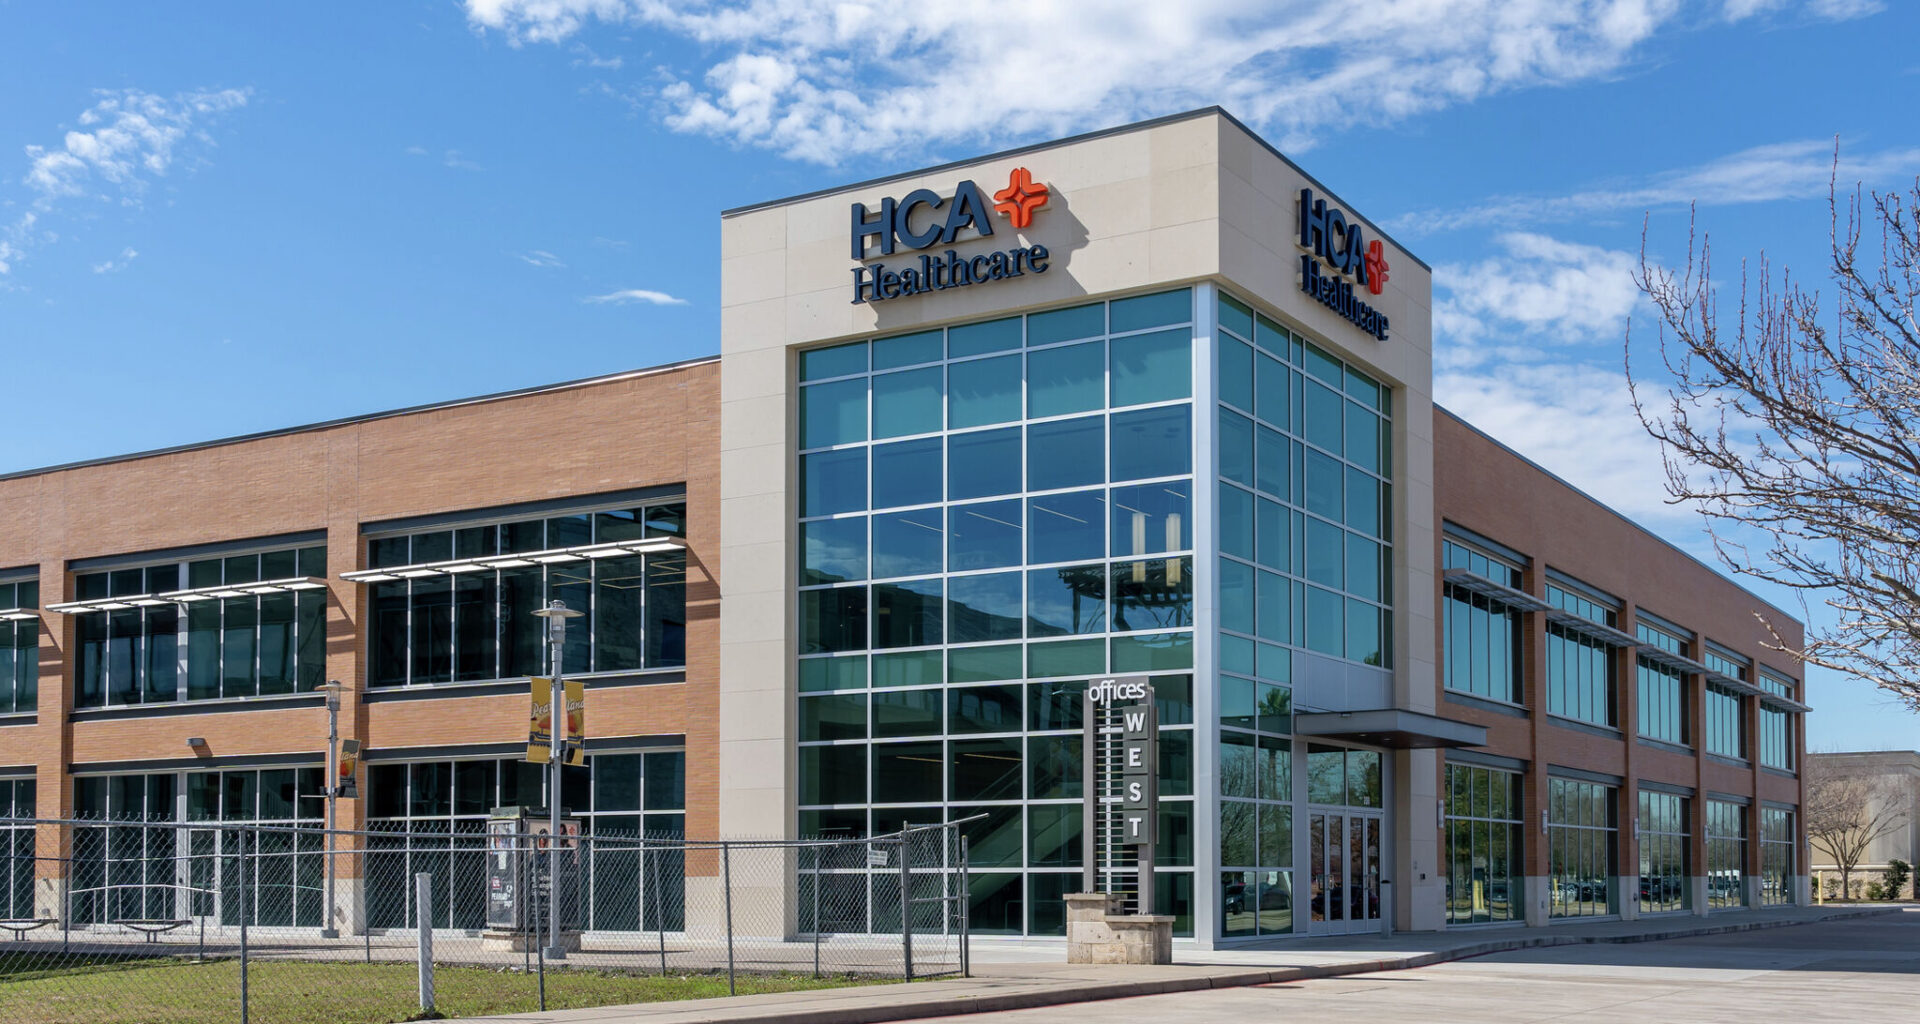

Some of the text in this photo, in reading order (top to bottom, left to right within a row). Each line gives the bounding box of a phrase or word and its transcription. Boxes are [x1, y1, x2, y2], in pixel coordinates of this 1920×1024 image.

[851, 179, 994, 260] HCA
[1301, 188, 1368, 285] HCA
[851, 244, 1049, 305] Healthcare
[1301, 255, 1389, 341] Healthcare
[1088, 680, 1146, 705] offices
[1125, 712, 1146, 837] WEST
